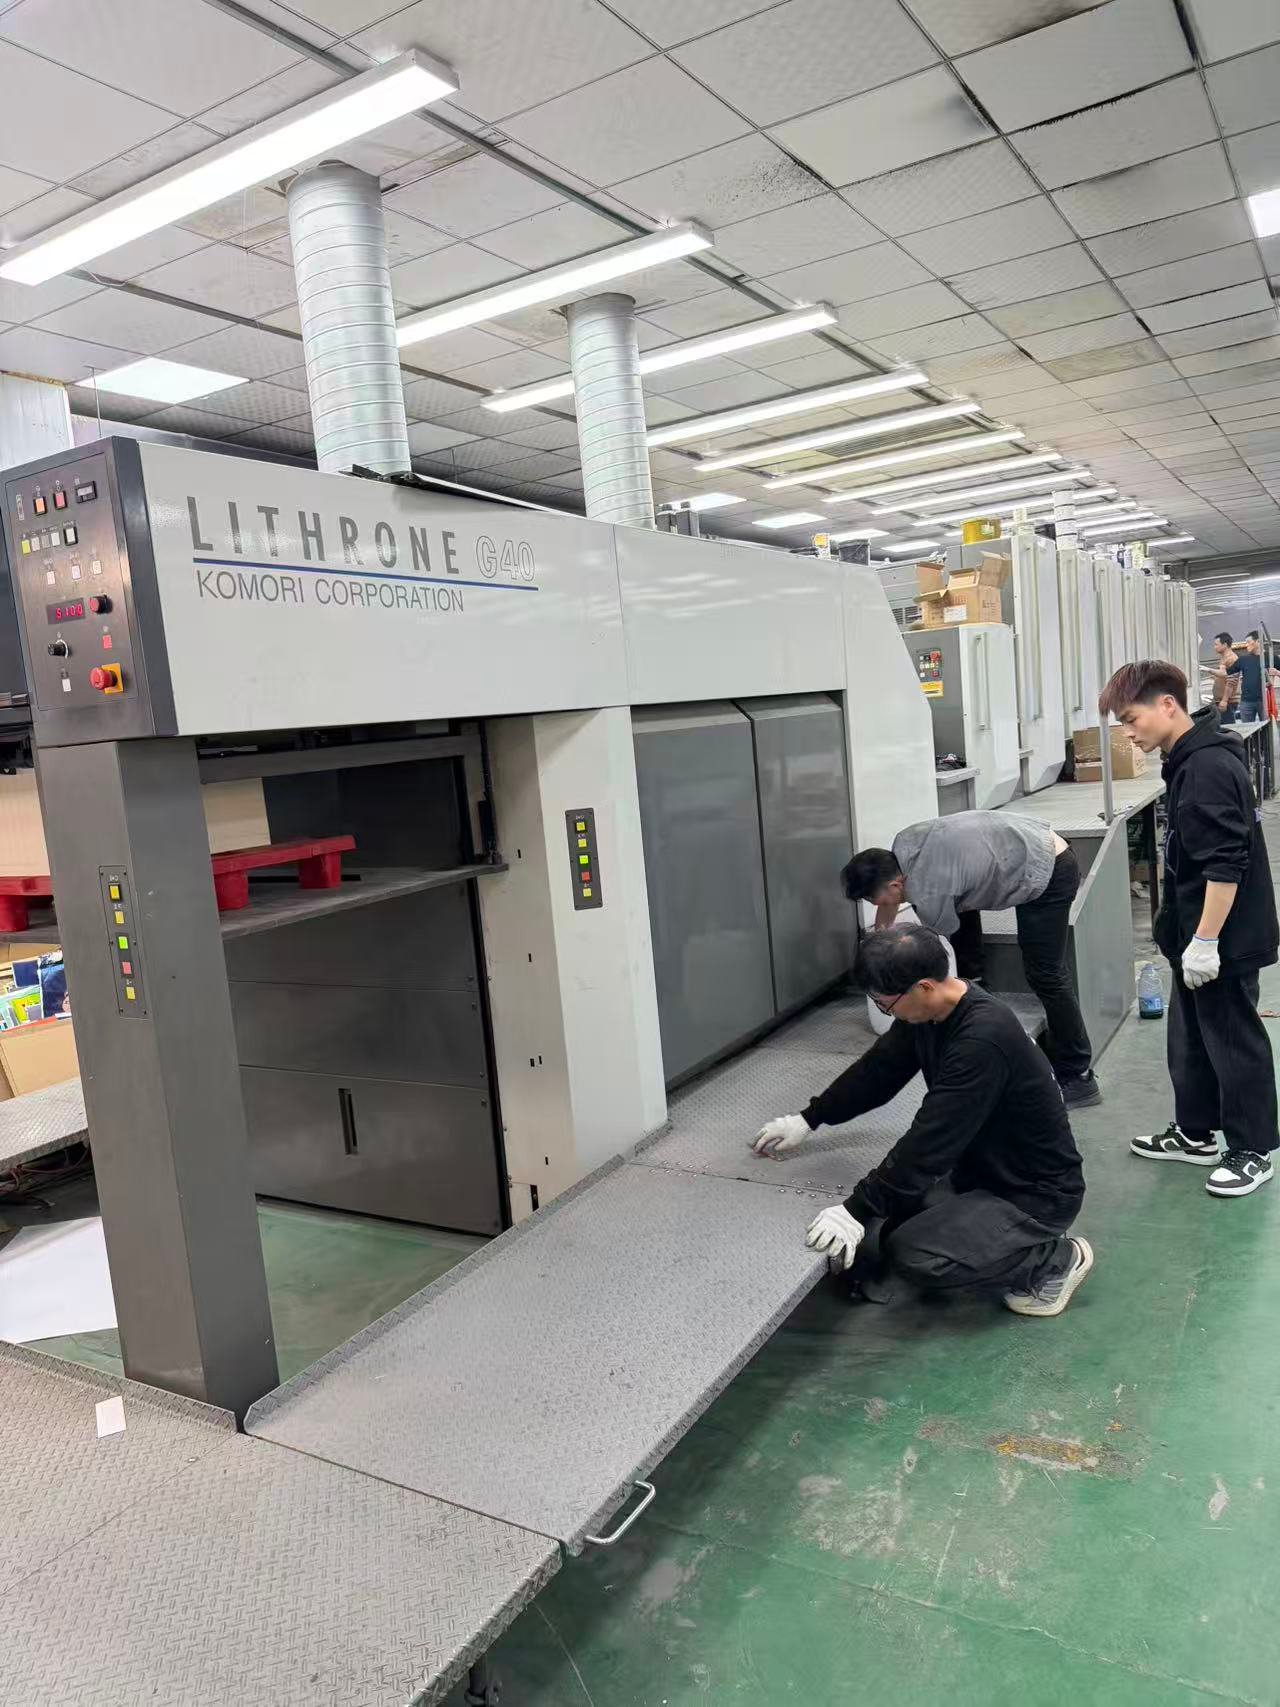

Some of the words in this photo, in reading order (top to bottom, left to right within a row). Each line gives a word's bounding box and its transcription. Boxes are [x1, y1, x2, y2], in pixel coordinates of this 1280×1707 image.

[187, 496, 459, 574] LITHRONE
[476, 535, 535, 582] G40
[196, 569, 304, 603] KOMORI
[315, 578, 464, 612] CORPORATION
